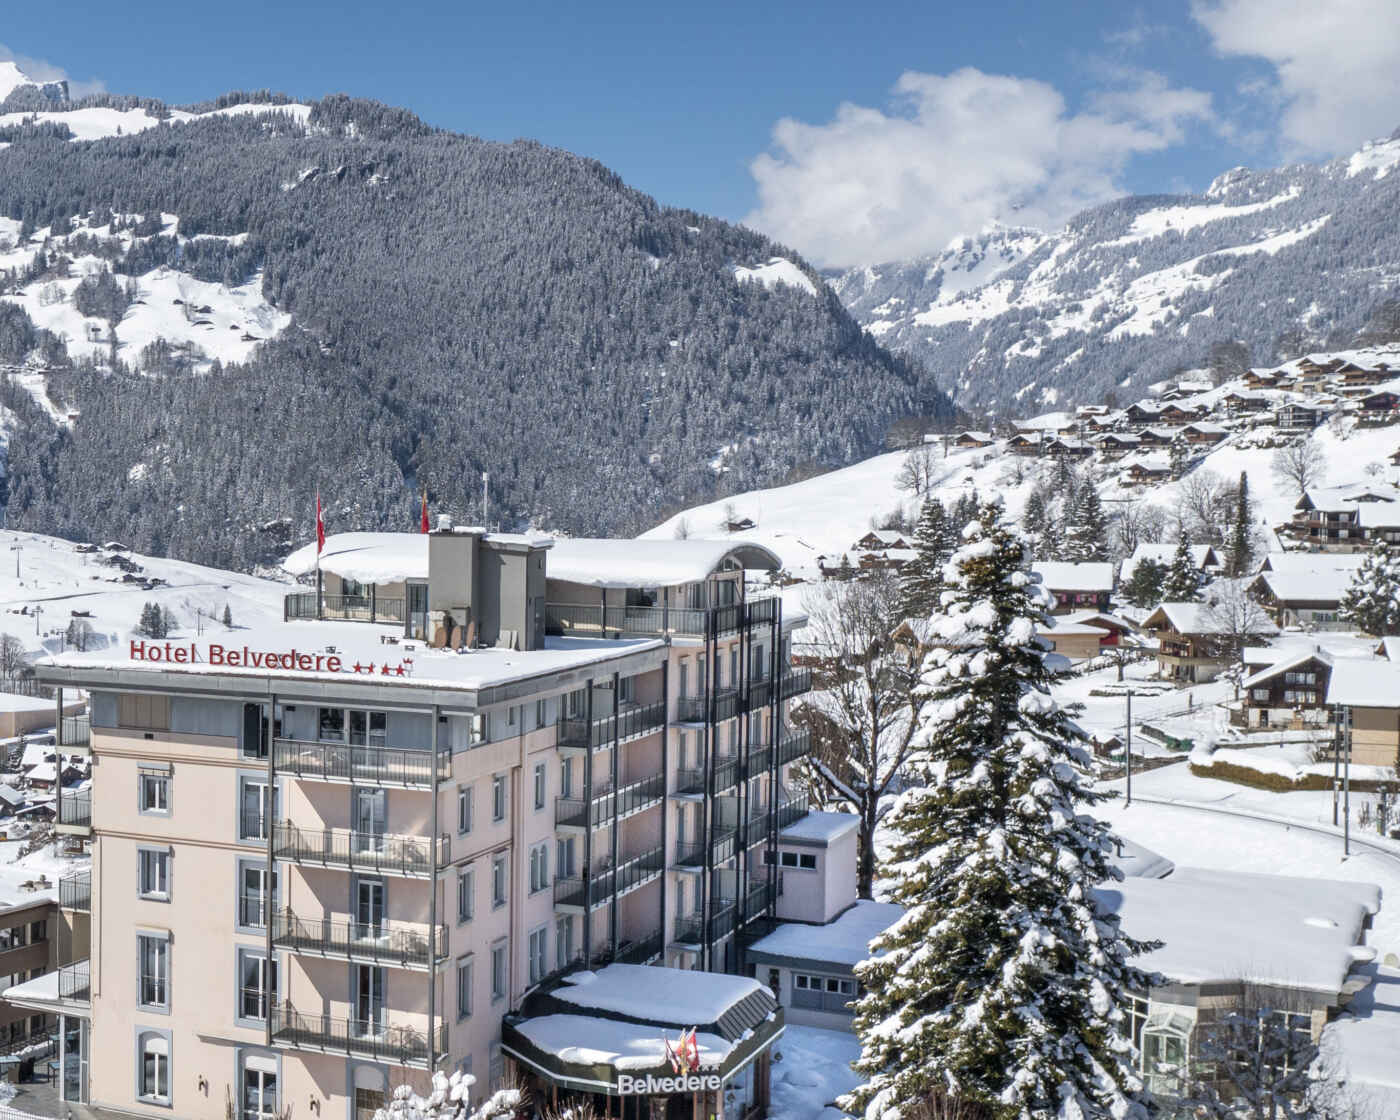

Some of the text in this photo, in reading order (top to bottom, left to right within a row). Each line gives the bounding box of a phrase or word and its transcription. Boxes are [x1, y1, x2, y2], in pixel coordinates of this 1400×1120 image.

[130, 640, 342, 673] Hotel Belvedere
[618, 1074, 721, 1095] Belvedere
